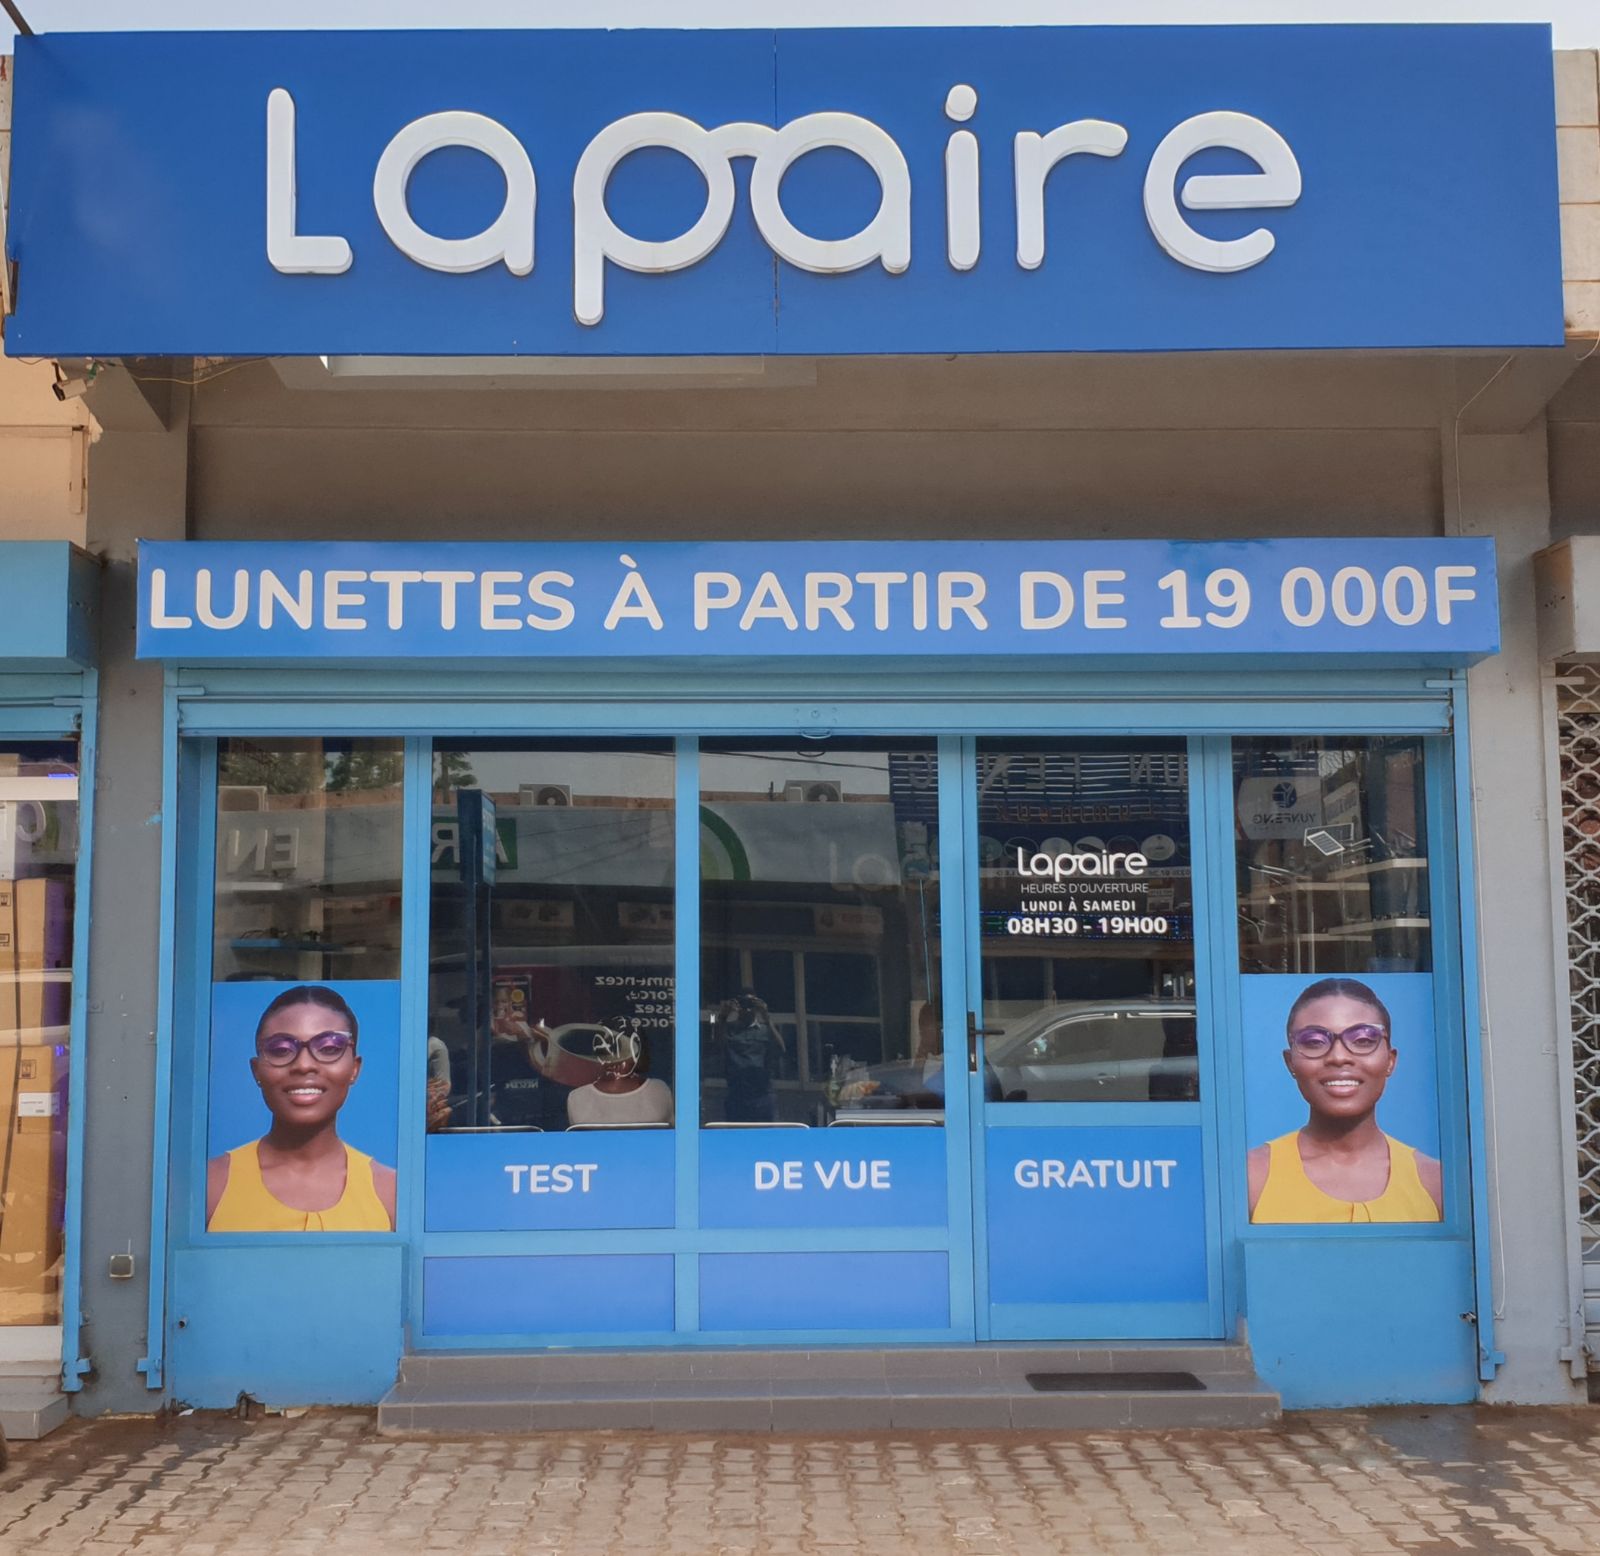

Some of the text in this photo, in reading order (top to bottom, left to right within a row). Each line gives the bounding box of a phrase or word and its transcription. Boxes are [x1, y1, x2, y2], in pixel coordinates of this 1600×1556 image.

[266, 85, 1302, 326] Lapaire
[150, 554, 1477, 632] LUNETTES À PARTIR DE 19 000F
[1017, 846, 1148, 883] Lapaire
[1020, 883, 1067, 894] HEURES
[1068, 882, 1149, 894] D'OUVERTURE
[1021, 897, 1136, 912] LUNDI À SAMEDI
[1007, 917, 1078, 934] 08H30
[1098, 917, 1168, 934] 19H00
[504, 1163, 599, 1194] TEST
[754, 1160, 891, 1190] DE VUE
[1014, 1159, 1178, 1189] GRATUIT
